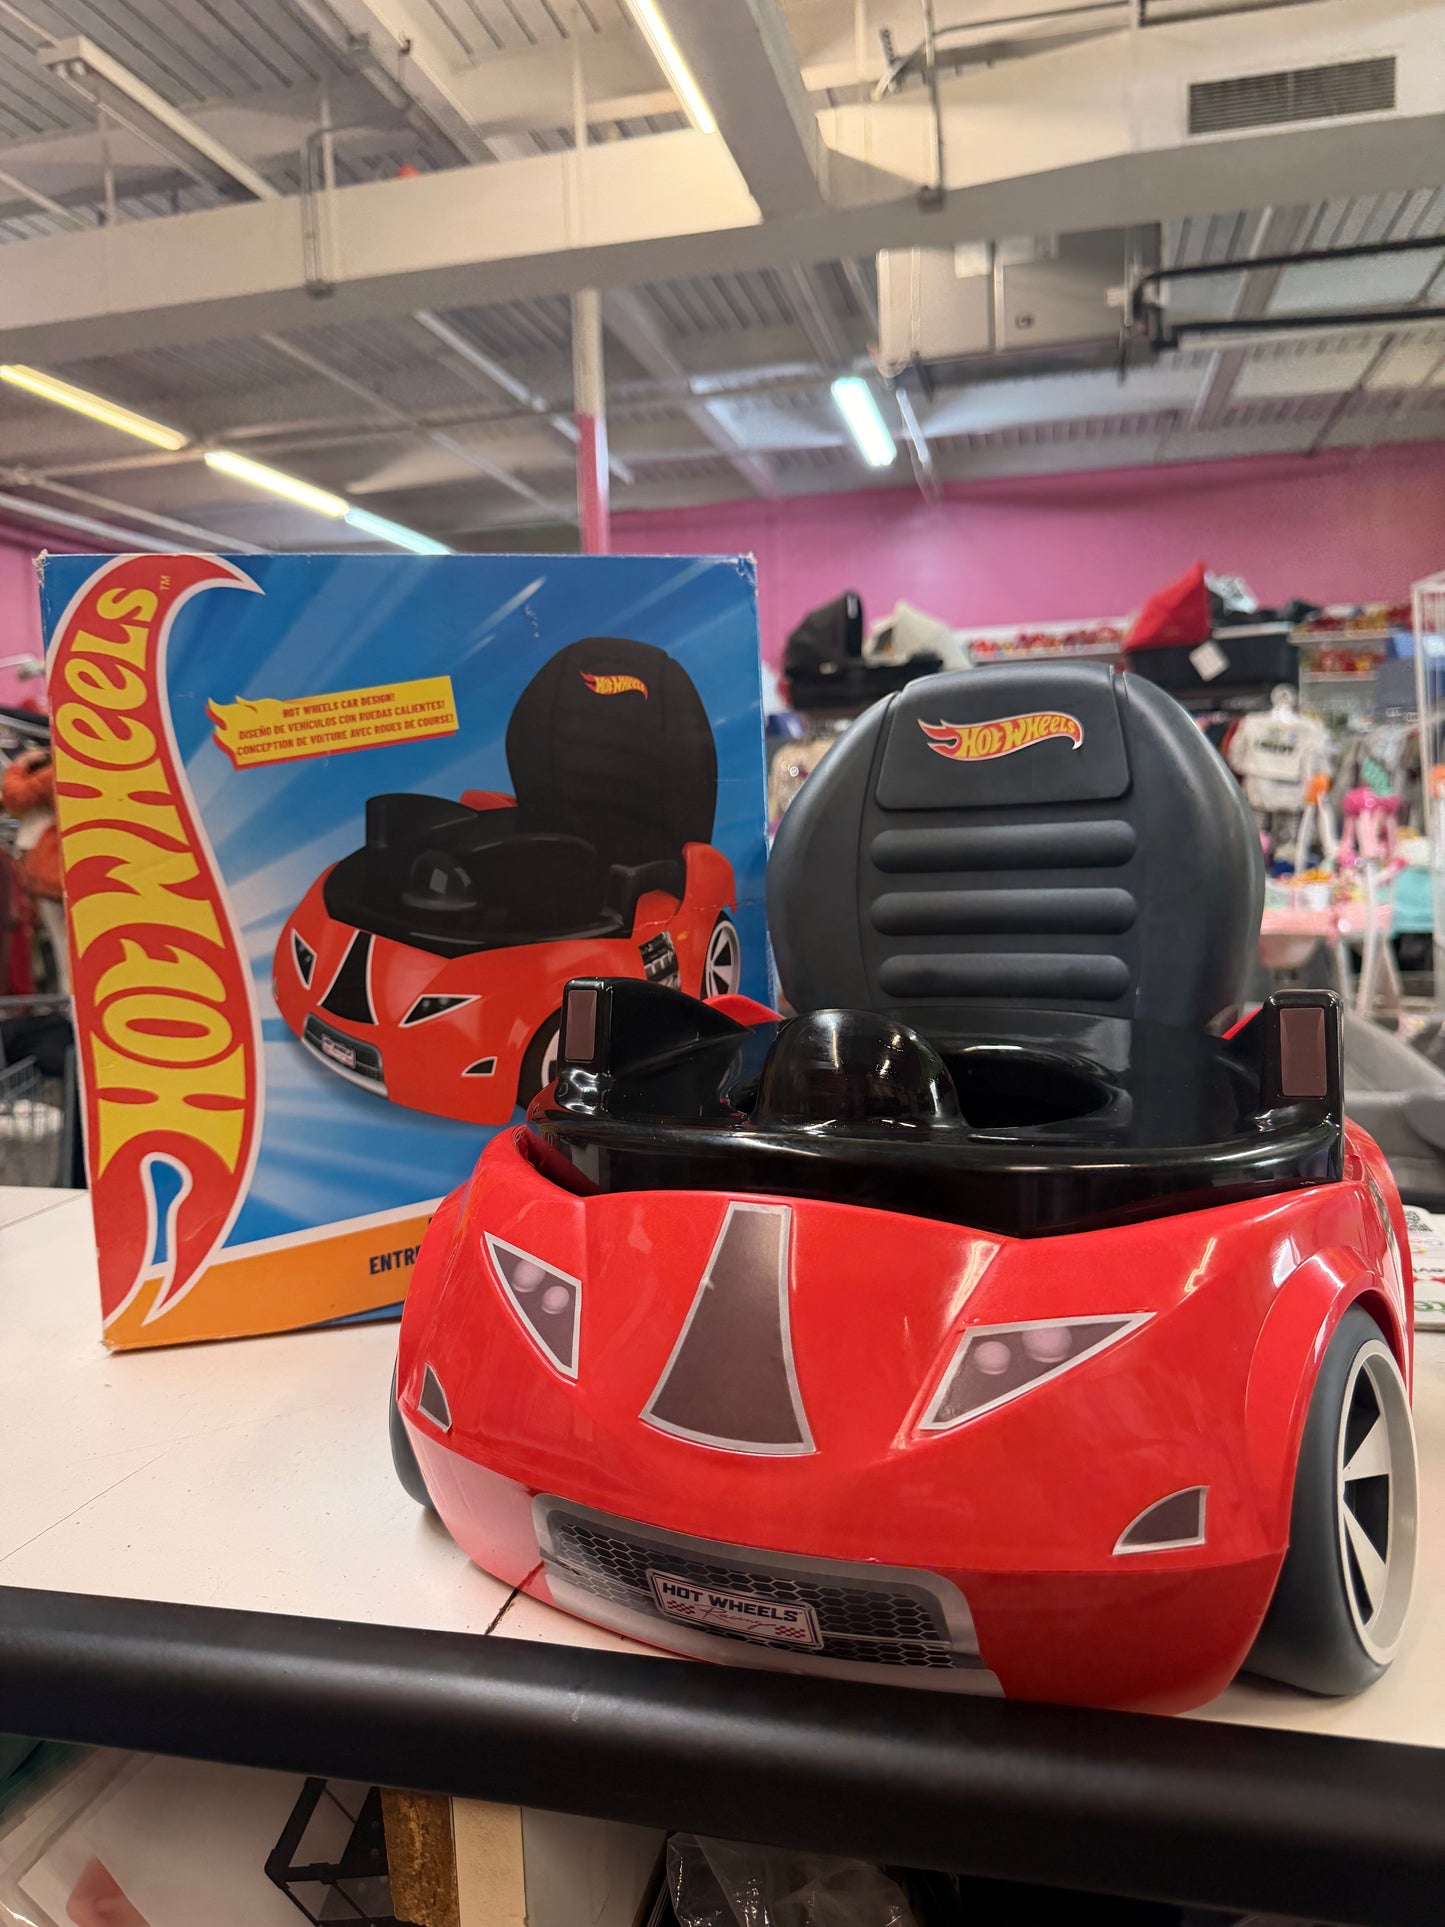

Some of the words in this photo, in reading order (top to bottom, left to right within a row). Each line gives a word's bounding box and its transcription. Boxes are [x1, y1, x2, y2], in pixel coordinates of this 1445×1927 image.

[274, 724, 286, 735] DE
[339, 714, 357, 725] CON
[359, 708, 393, 721] RUEDAS
[394, 700, 445, 716] CALIENTES!
[283, 706, 301, 718] HOT
[303, 701, 340, 715] WHEELS
[341, 699, 359, 709] CAR
[361, 693, 395, 706] DESIGN!
[237, 739, 294, 756] CONCEPTION
[296, 736, 308, 747] DE
[310, 730, 348, 744] VOITURE
[350, 727, 372, 738] AVEC
[374, 722, 403, 734] ROUES
[404, 719, 416, 730] DE
[417, 713, 455, 728] COURSE!
[952, 727, 1003, 758] HOT
[90, 937, 246, 1180] HOT
[662, 1582, 704, 1603] HOT
[708, 1594, 798, 1623] WHEELS
